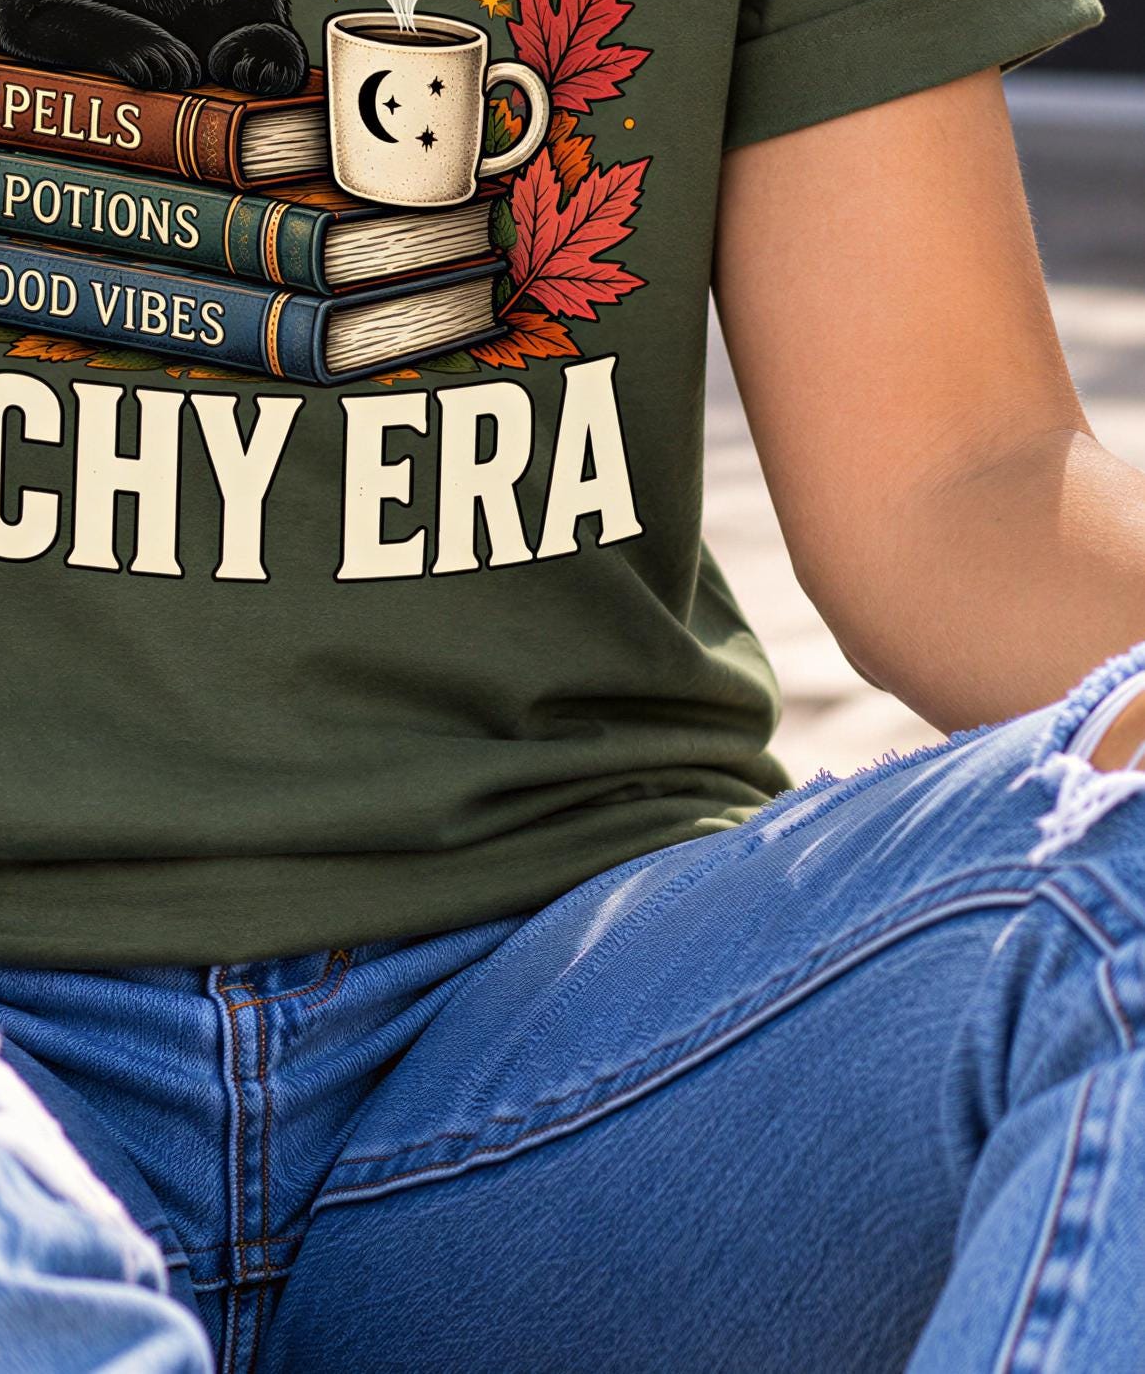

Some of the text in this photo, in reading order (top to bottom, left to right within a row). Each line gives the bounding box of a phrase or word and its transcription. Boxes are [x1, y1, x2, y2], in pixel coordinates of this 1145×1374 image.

[2, 173, 200, 249] POTIONS
[90, 280, 225, 346] VIBES
[335, 355, 644, 580] ERA
